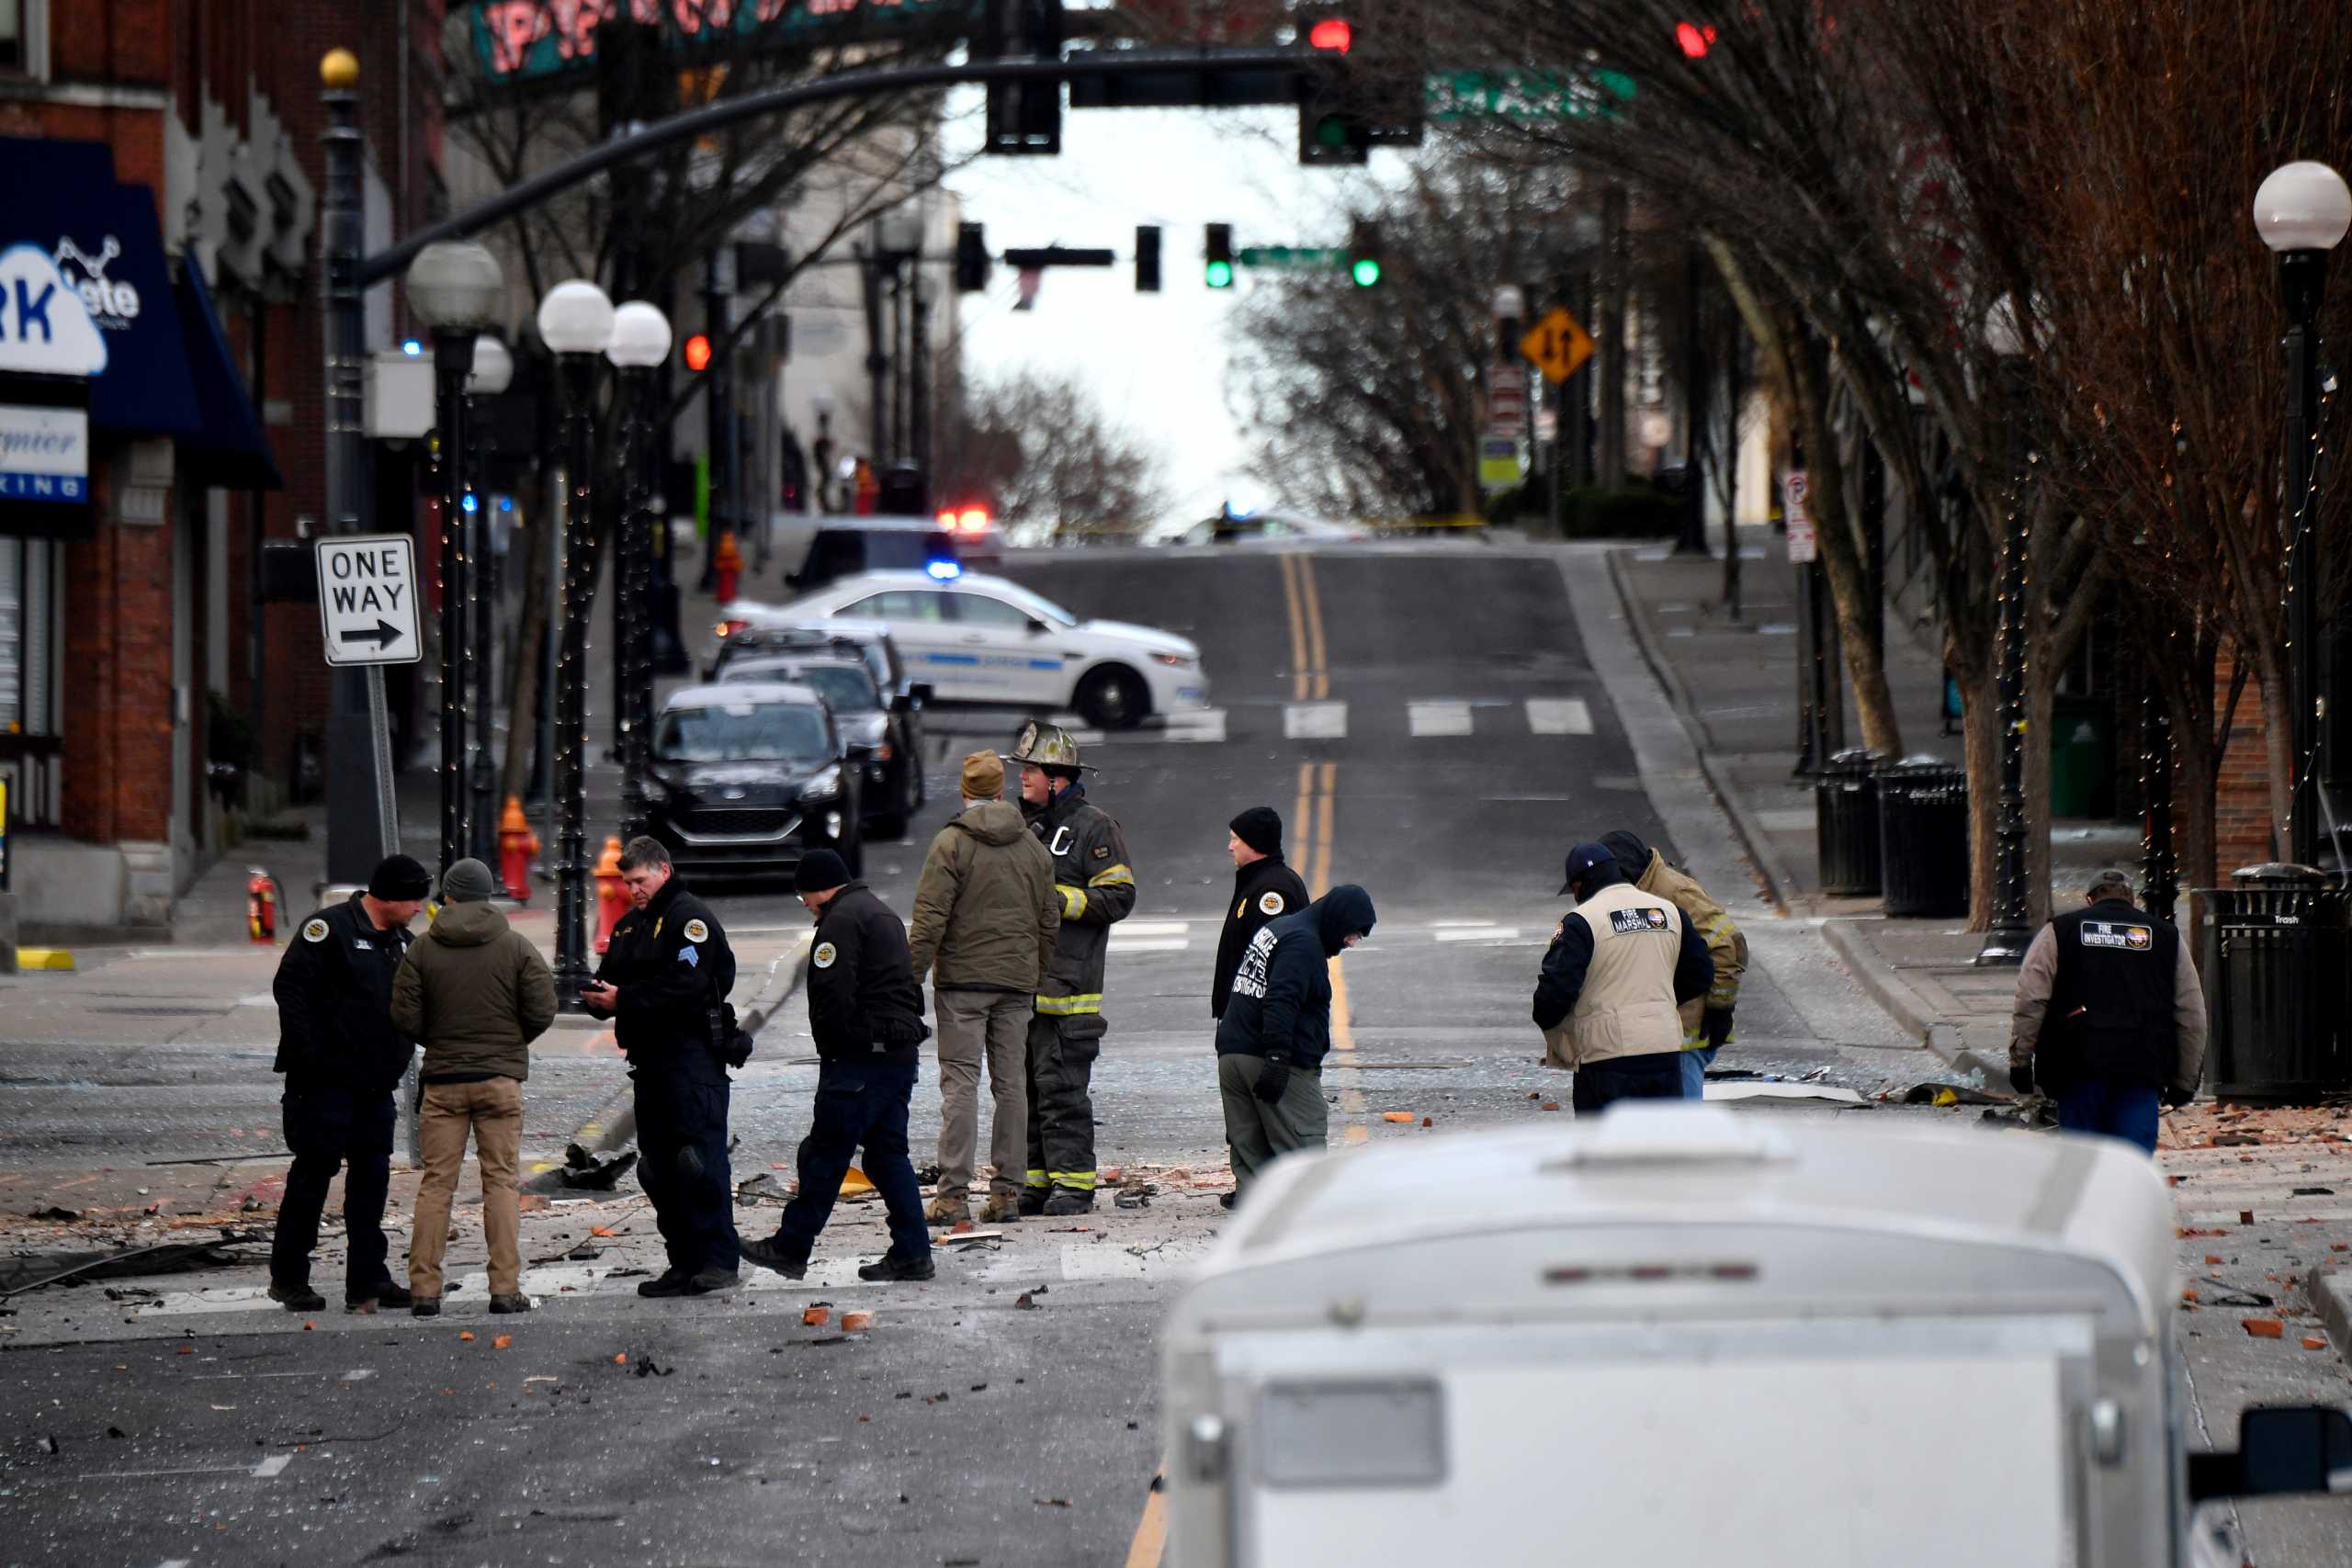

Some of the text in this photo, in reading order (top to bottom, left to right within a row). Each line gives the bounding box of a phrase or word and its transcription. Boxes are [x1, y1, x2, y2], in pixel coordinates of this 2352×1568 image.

[0, 277, 55, 344] K
[332, 549, 401, 581] ONE
[333, 583, 405, 615] WAY
[1621, 909, 1639, 919] FIRE
[2275, 915, 2300, 924] Trash
[2098, 924, 2112, 934] FIRE
[2084, 932, 2126, 946] INVESTIGATOR
